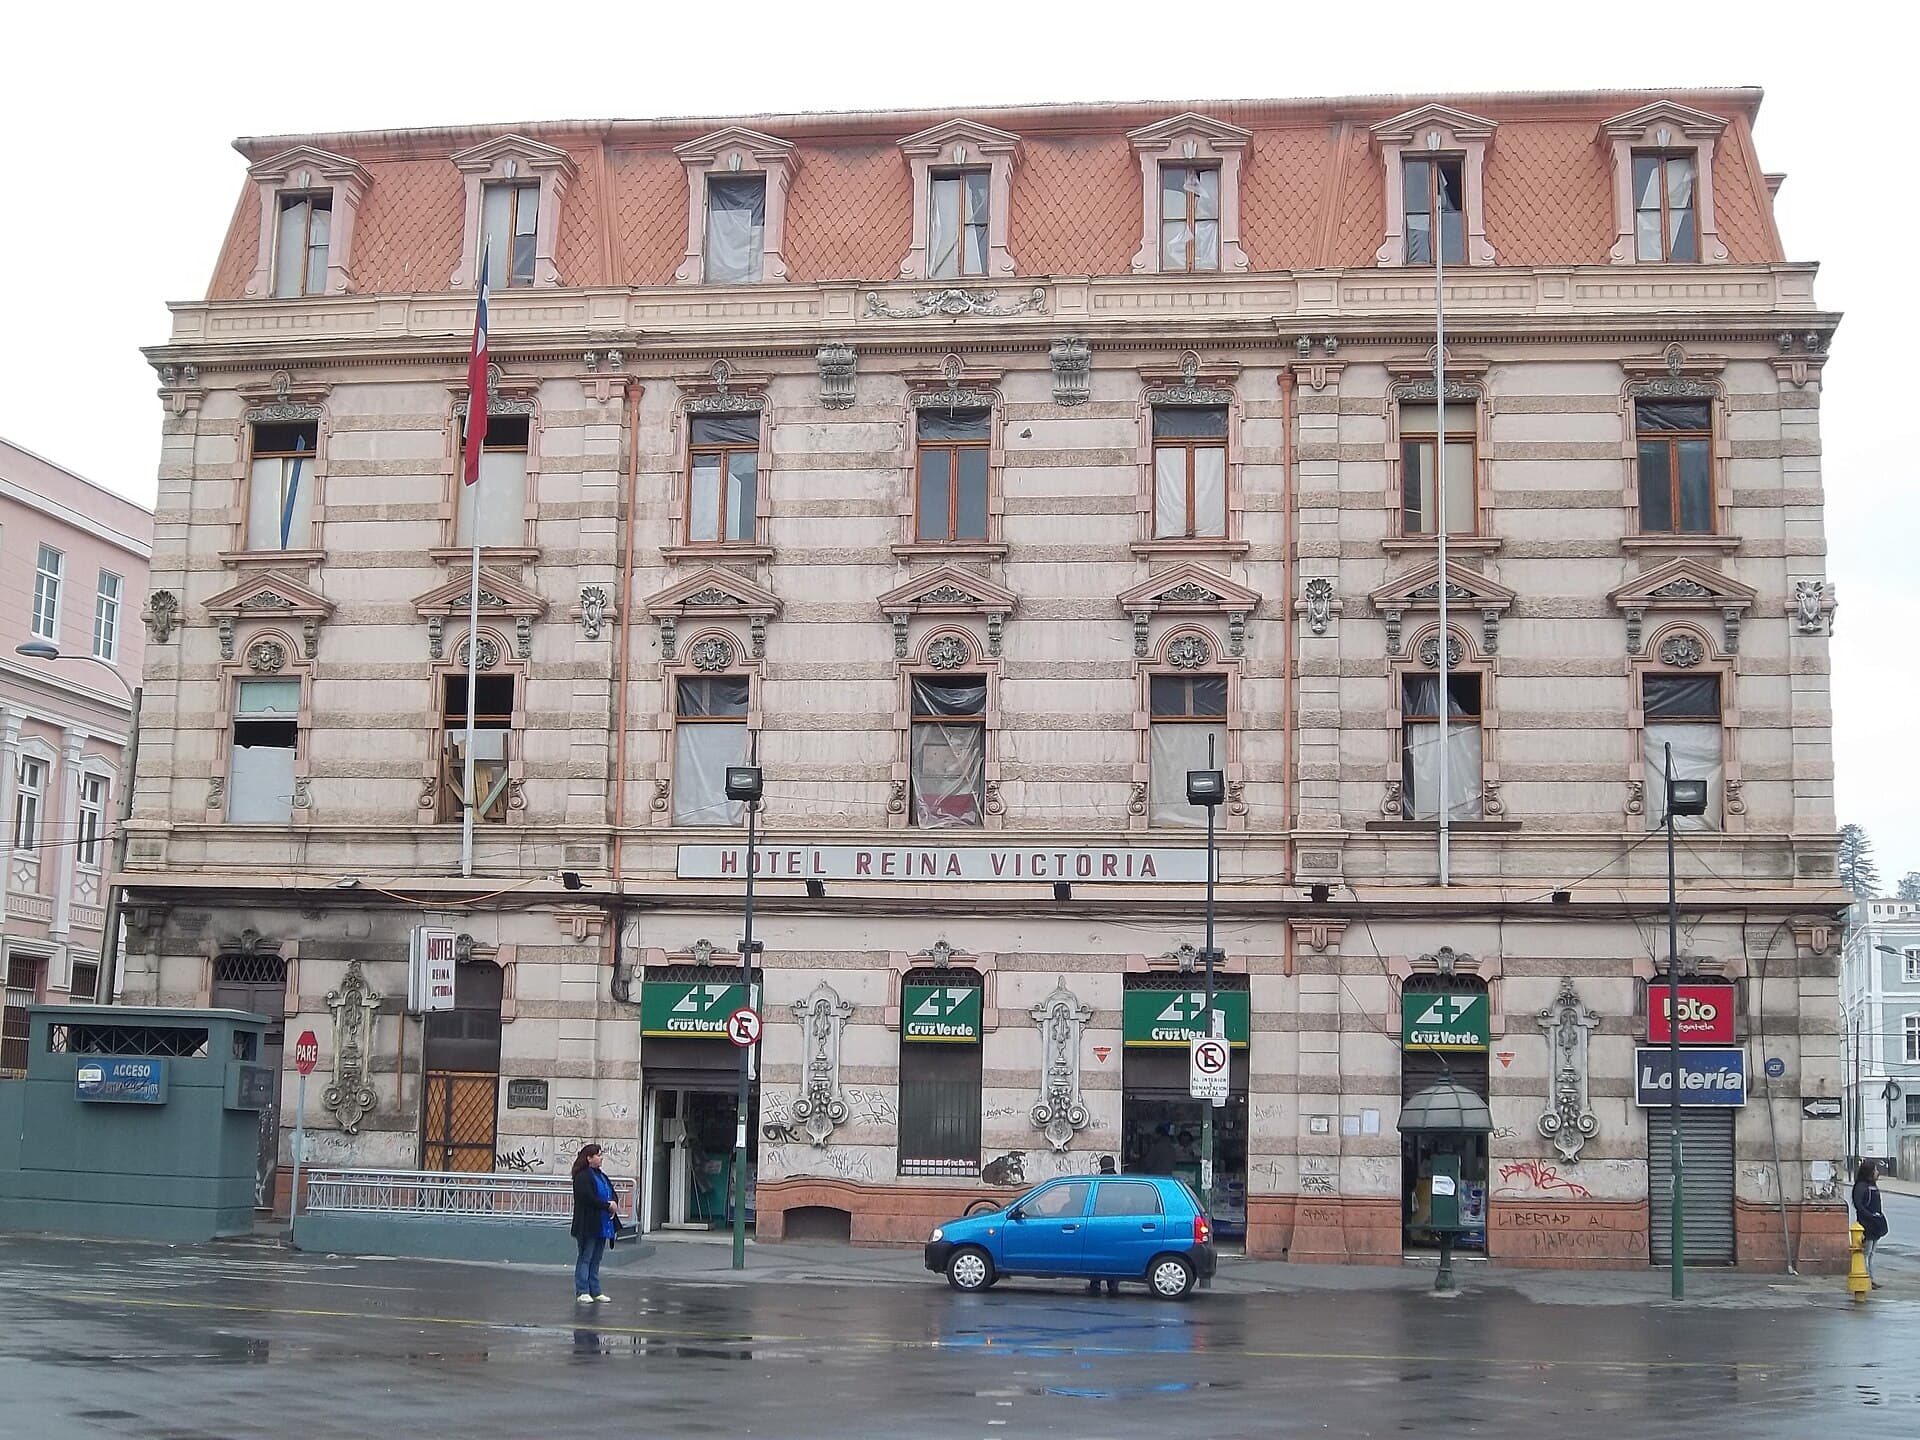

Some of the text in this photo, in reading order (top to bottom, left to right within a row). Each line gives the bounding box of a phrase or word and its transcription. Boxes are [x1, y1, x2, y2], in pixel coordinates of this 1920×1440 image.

[856, 852, 961, 875] REINA
[990, 853, 1157, 876] VICTORIA
[427, 938, 454, 960] HOTEL
[432, 968, 449, 980] REINA
[296, 1044, 317, 1062] PARE
[1204, 1047, 1217, 1068] E
[112, 1064, 151, 1077] ACCESO
[1641, 1066, 1743, 1090] Lotería
